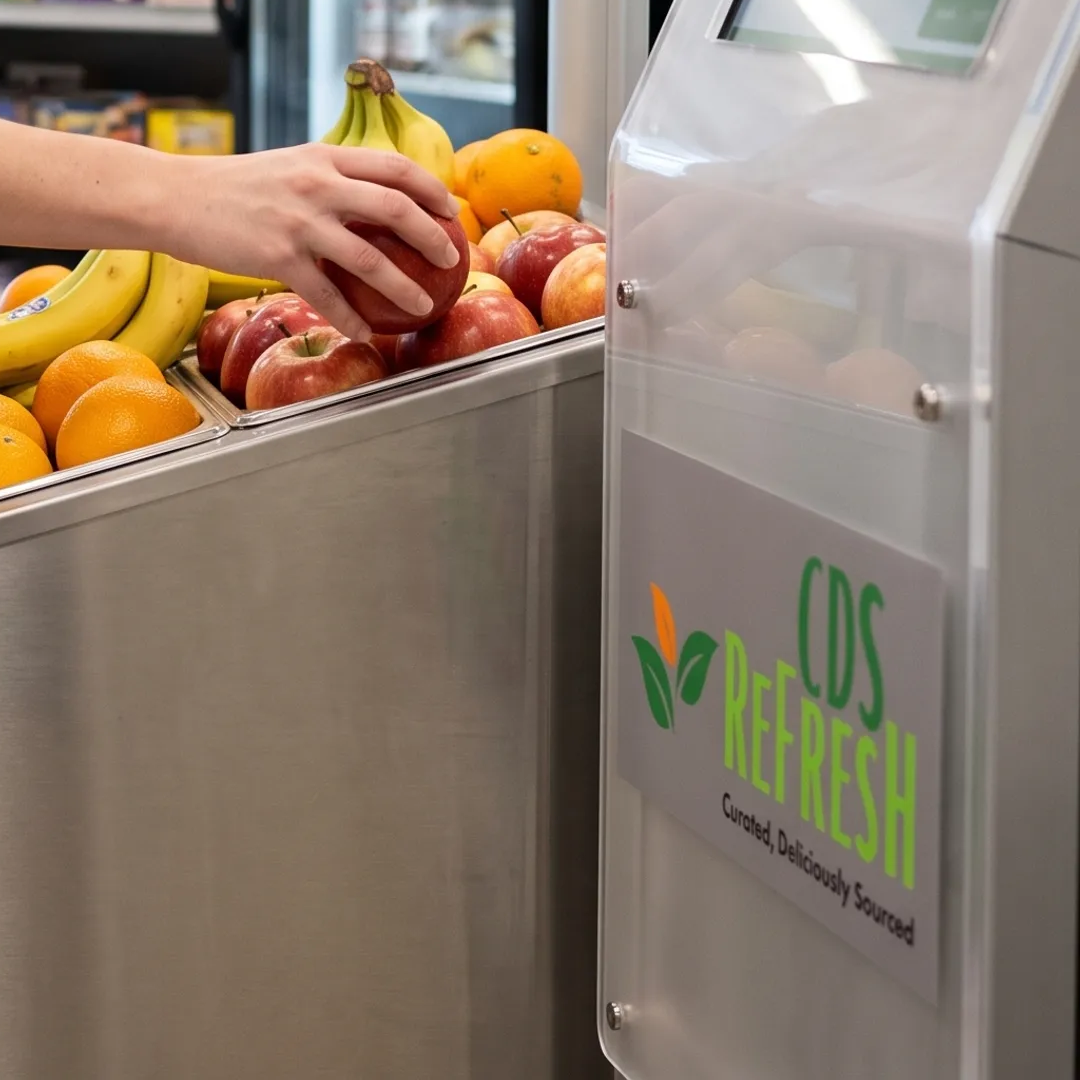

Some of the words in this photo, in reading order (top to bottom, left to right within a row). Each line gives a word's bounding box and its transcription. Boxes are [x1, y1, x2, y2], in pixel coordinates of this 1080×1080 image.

[797, 556, 885, 733] CDS
[722, 792, 775, 855] Curated,
[778, 828, 851, 908] Deliciously
[854, 881, 915, 947] Sourced
